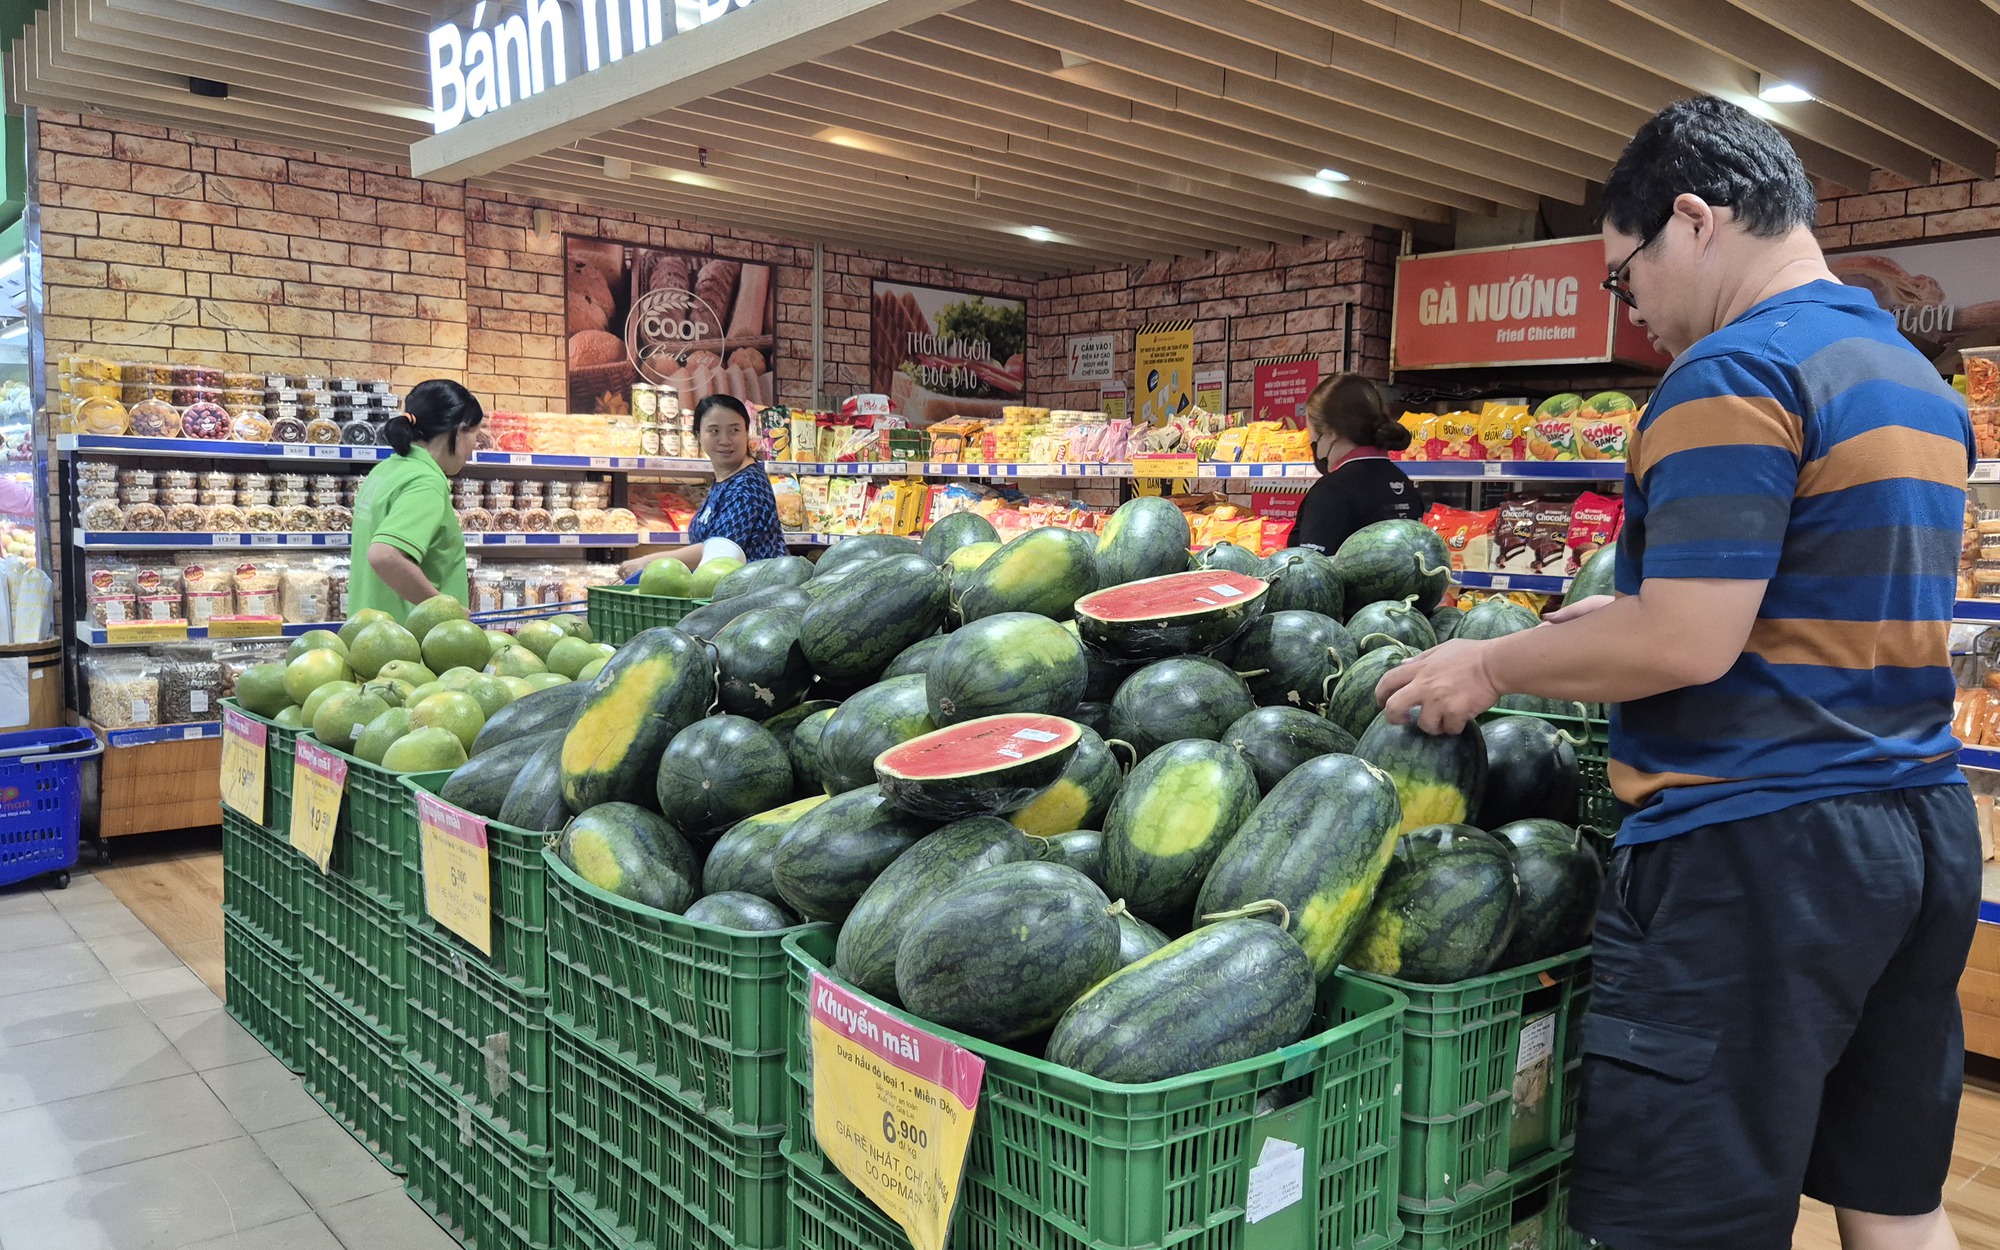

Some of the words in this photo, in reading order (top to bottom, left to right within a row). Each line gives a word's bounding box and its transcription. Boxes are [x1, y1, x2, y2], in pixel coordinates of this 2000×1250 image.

[428, 0, 566, 134] Bánh
[1419, 281, 1458, 326] GÀ
[1467, 273, 1579, 323] NƯỚNG
[644, 316, 709, 341] CO.OP
[1496, 327, 1525, 343] Fried
[1527, 325, 1576, 341] Chicken
[817, 985, 879, 1042] Khuyến
[882, 1029, 920, 1063] mãi
[837, 1044, 853, 1062] Dưa
[854, 1054, 870, 1071] hấu
[882, 1071, 898, 1089] loại
[900, 1081, 905, 1092] 1
[914, 1086, 937, 1107] Miền
[836, 1120, 853, 1143] GIÁ
